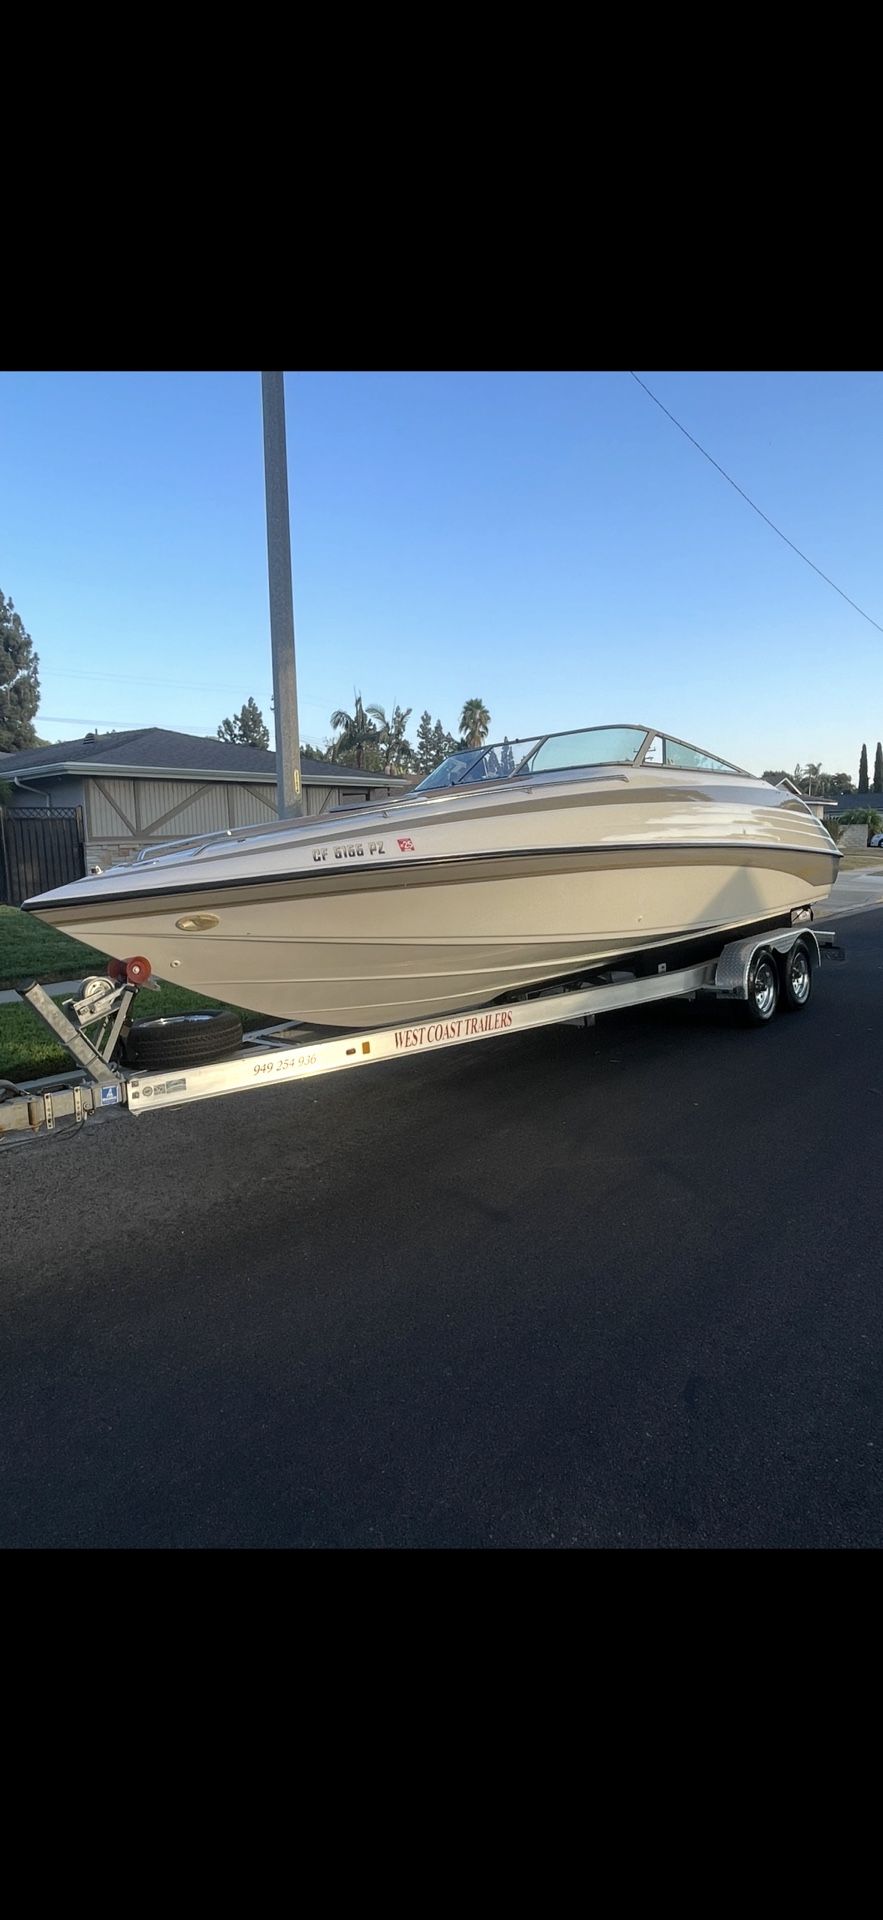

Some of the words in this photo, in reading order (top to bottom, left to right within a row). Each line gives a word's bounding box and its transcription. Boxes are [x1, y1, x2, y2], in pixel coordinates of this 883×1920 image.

[312, 847, 328, 861] CF
[368, 841, 385, 855] PZ
[394, 1027, 425, 1049] WEST
[427, 1020, 463, 1043] COAST
[464, 1010, 513, 1036] TRAILERS
[253, 1062, 274, 1076] 949
